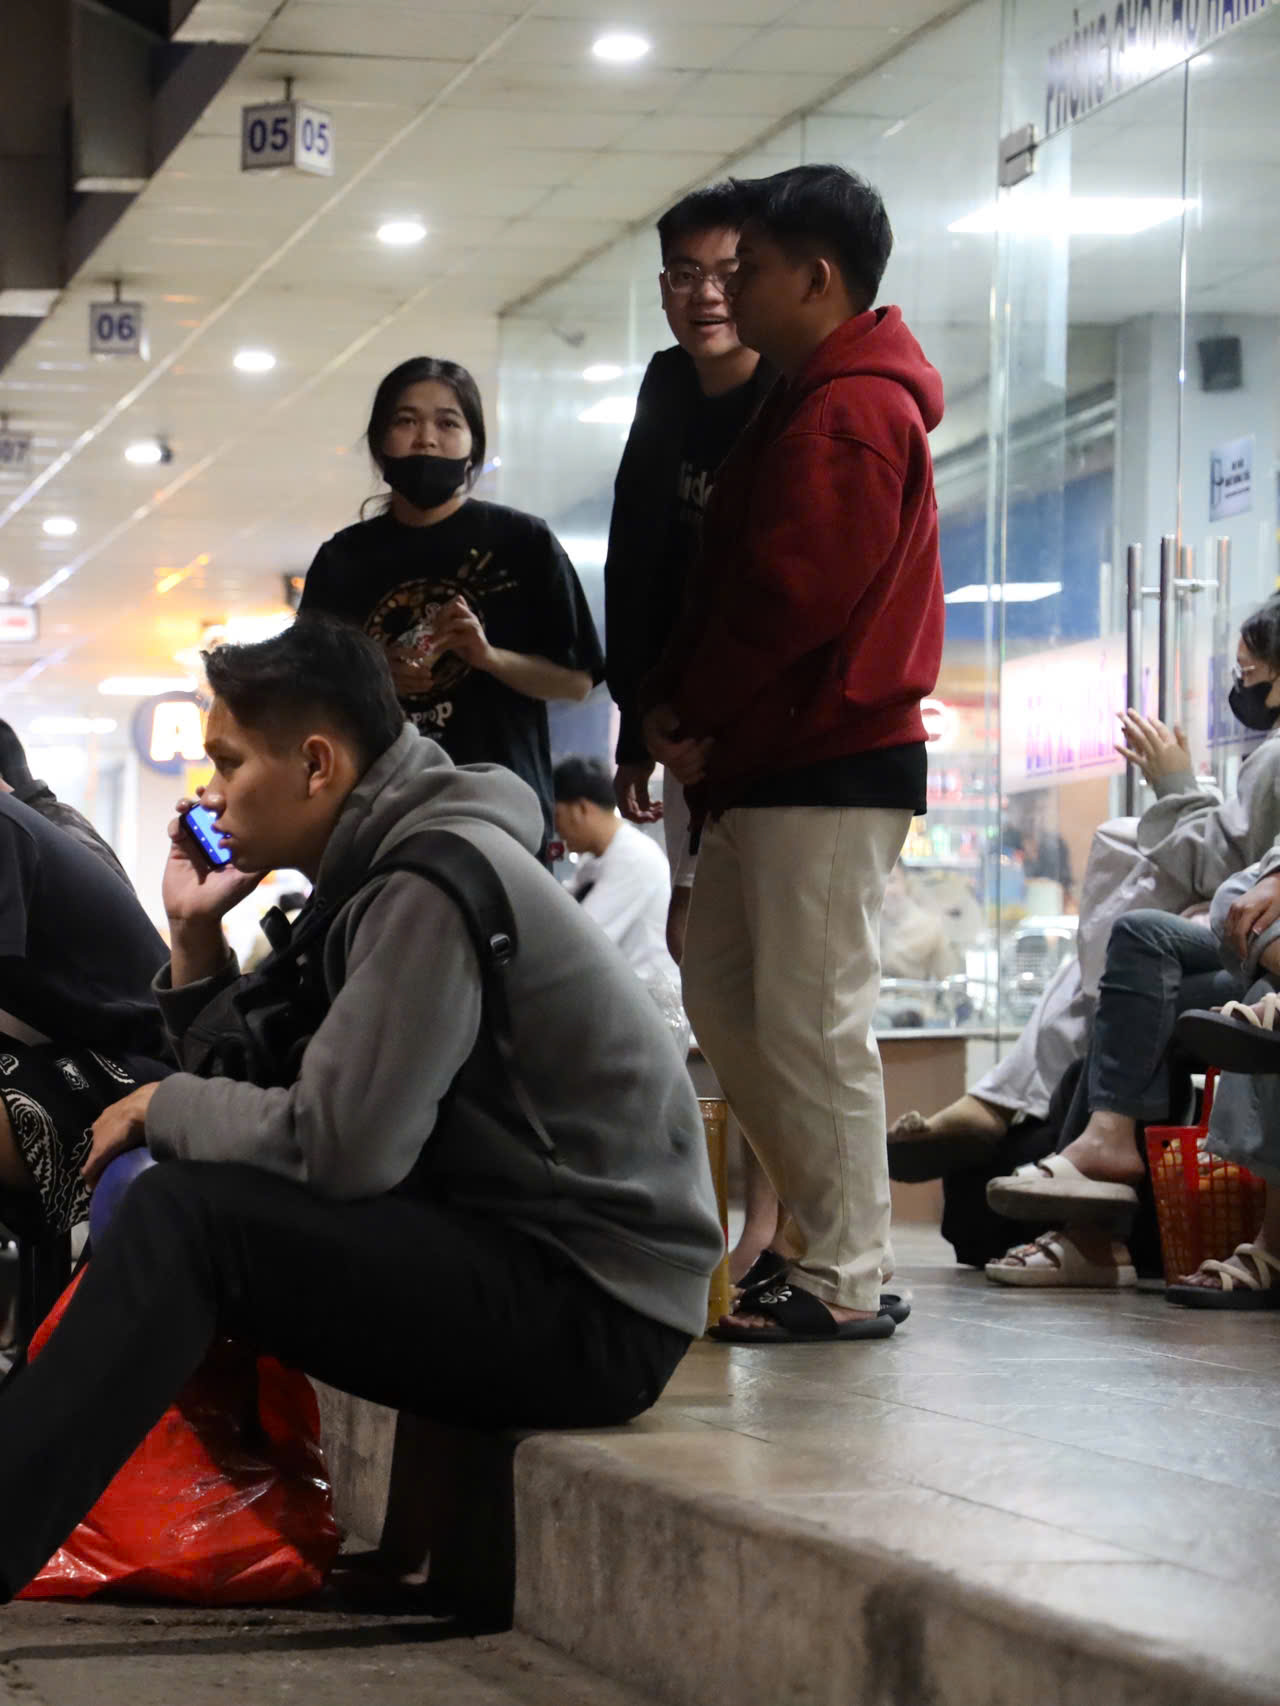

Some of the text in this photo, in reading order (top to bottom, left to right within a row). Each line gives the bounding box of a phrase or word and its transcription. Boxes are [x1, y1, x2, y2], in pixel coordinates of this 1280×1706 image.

[249, 116, 289, 153] 05
[303, 118, 329, 156] 05
[97, 313, 135, 341] 06
